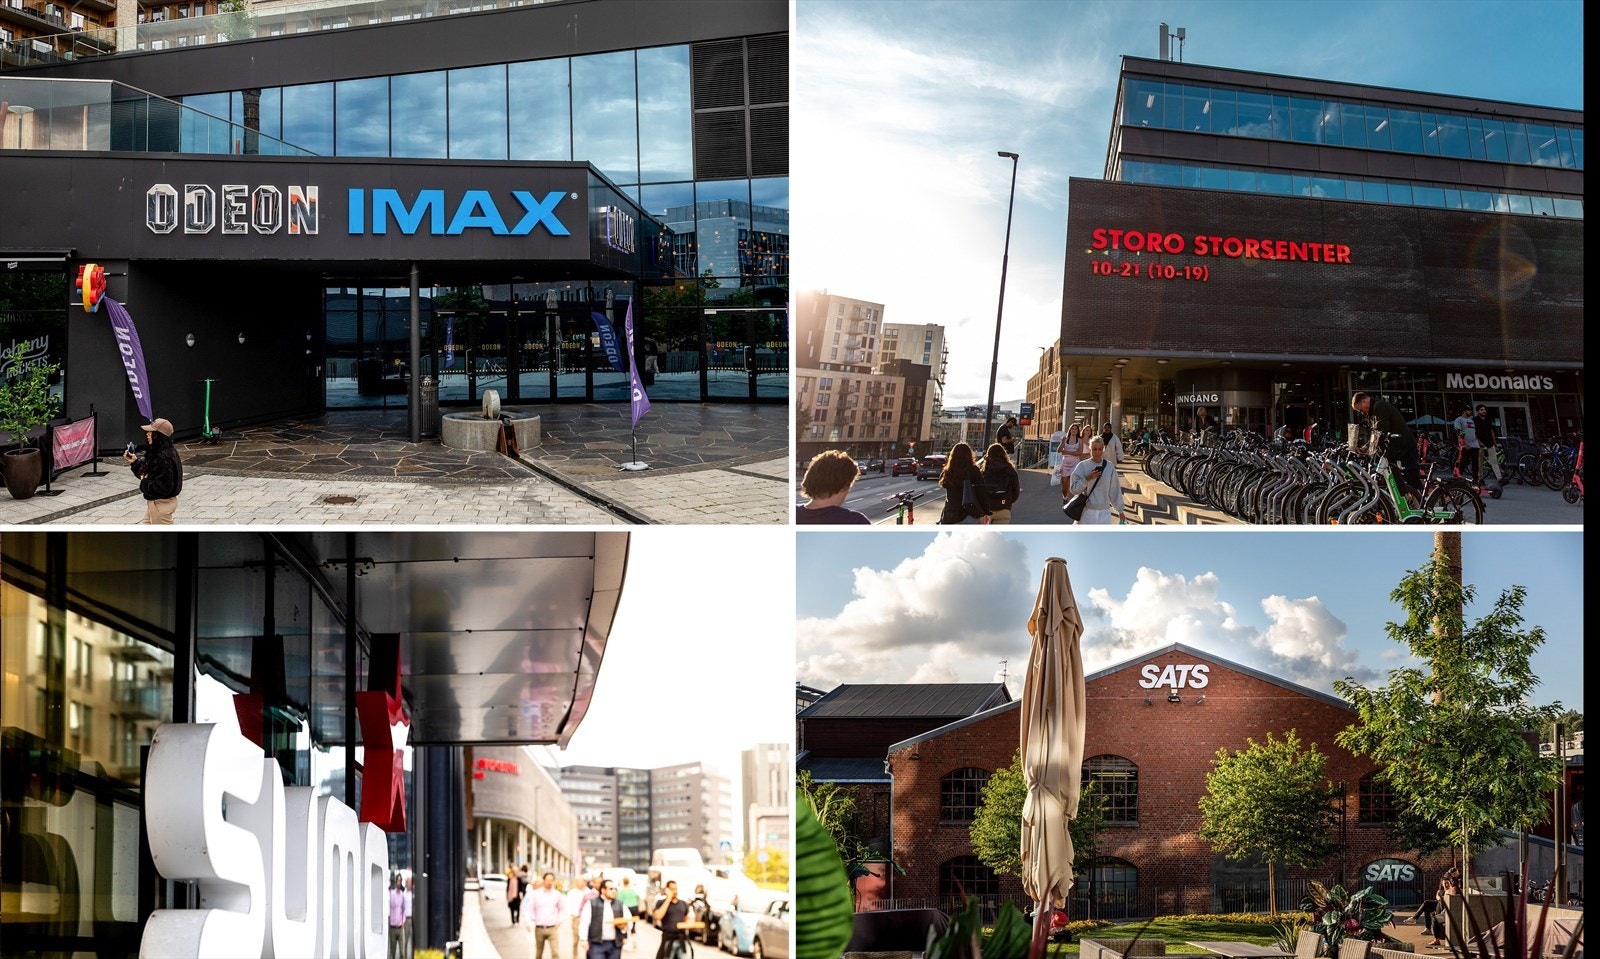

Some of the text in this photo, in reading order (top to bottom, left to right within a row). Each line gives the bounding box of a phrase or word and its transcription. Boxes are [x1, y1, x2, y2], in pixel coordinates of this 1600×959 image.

[146, 183, 319, 235] ODEON
[1092, 228, 1351, 263] STORO STORSENTER
[1091, 261, 1209, 282] 10-21 (10-19)
[1446, 373, 1554, 390] McDonald's
[1139, 664, 1209, 689] SATS
[1365, 864, 1415, 882] SATS
